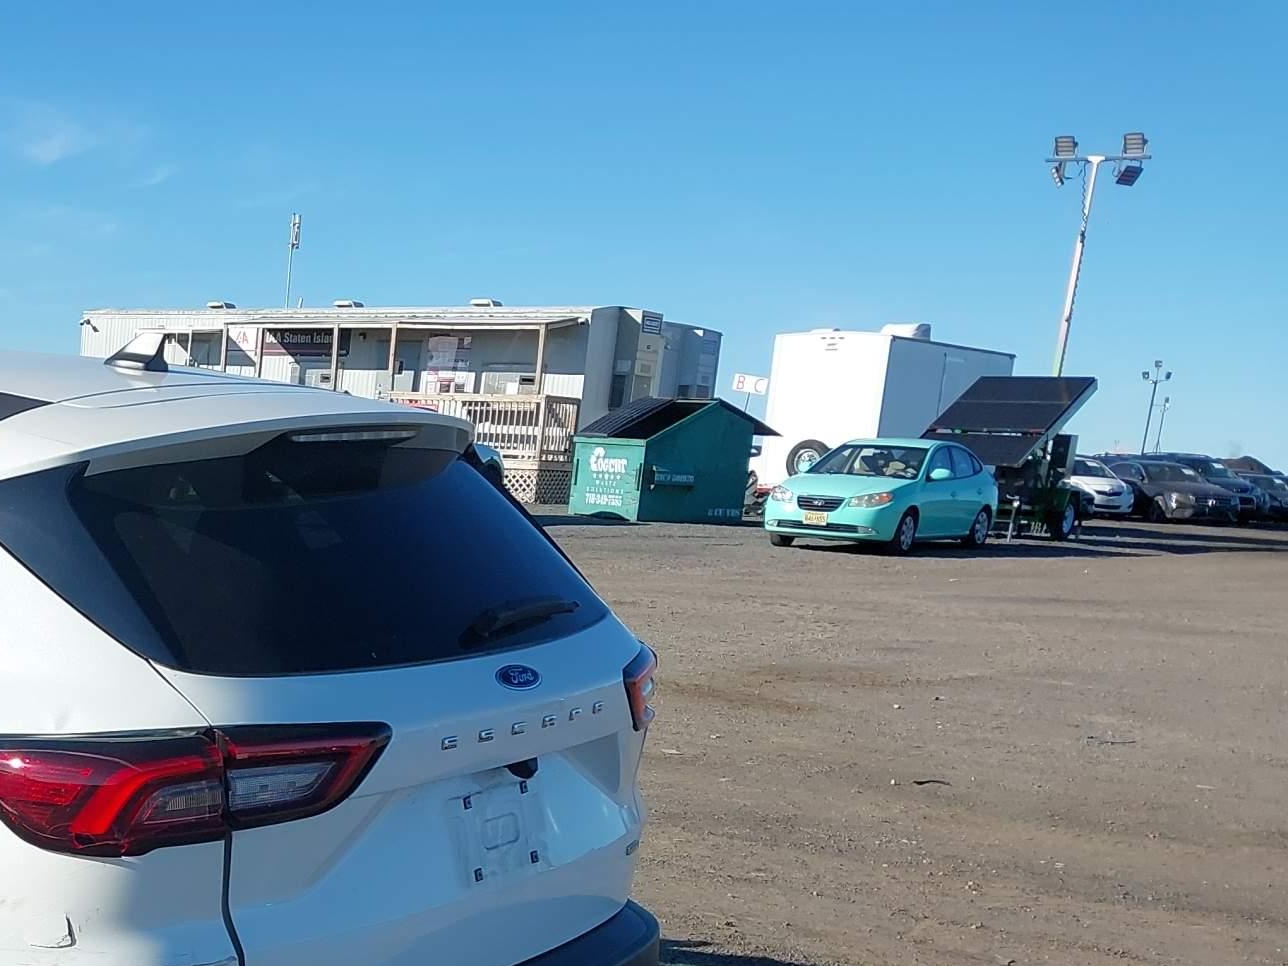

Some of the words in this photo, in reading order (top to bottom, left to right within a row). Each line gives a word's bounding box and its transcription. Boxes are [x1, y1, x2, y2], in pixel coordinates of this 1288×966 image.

[284, 332, 311, 344] Staten
[736, 375, 746, 390] B
[754, 379, 765, 393] C
[441, 701, 605, 750] ESCAPE
